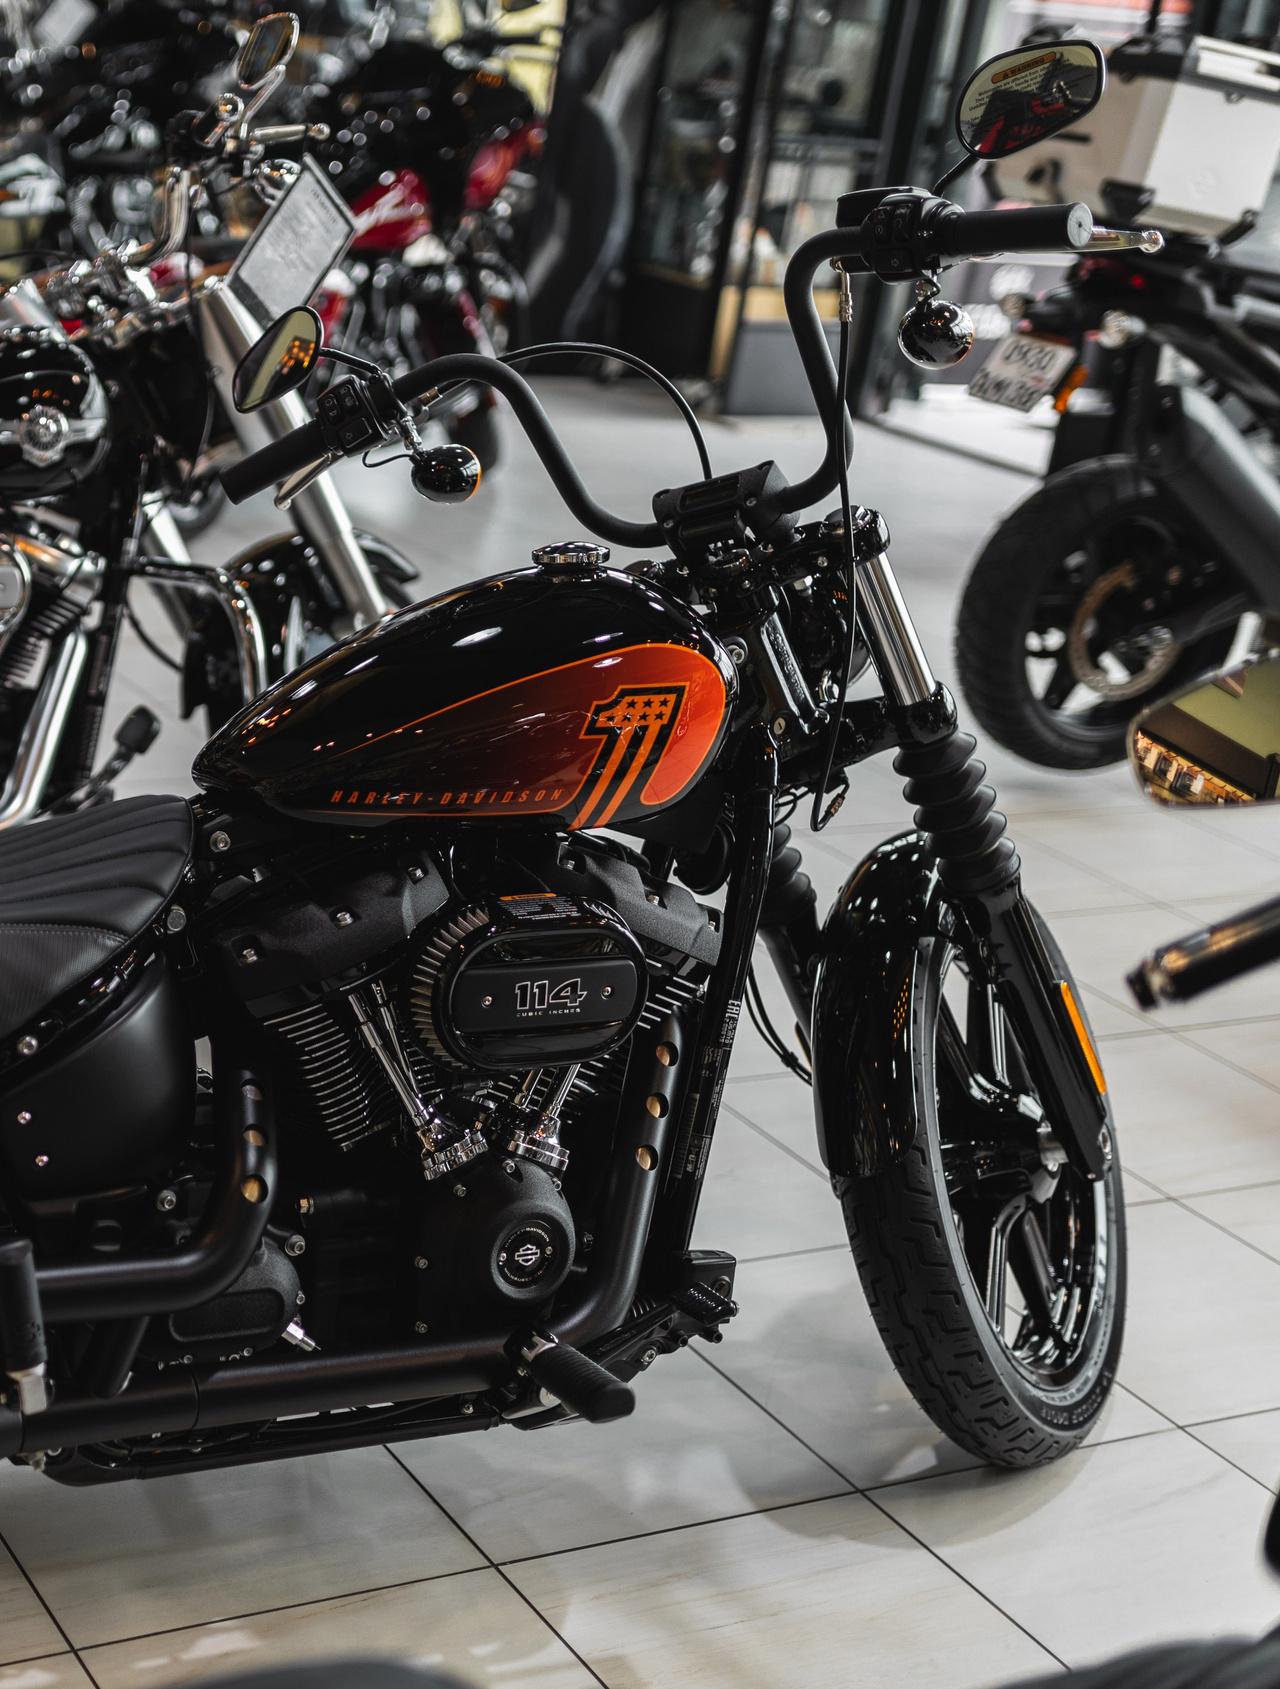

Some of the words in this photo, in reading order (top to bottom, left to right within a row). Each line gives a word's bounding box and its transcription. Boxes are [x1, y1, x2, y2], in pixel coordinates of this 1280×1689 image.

[1010, 57, 1045, 76] WARNING
[330, 788, 565, 806] HARLEY-DAVIDSON
[515, 978, 588, 1010] 114
